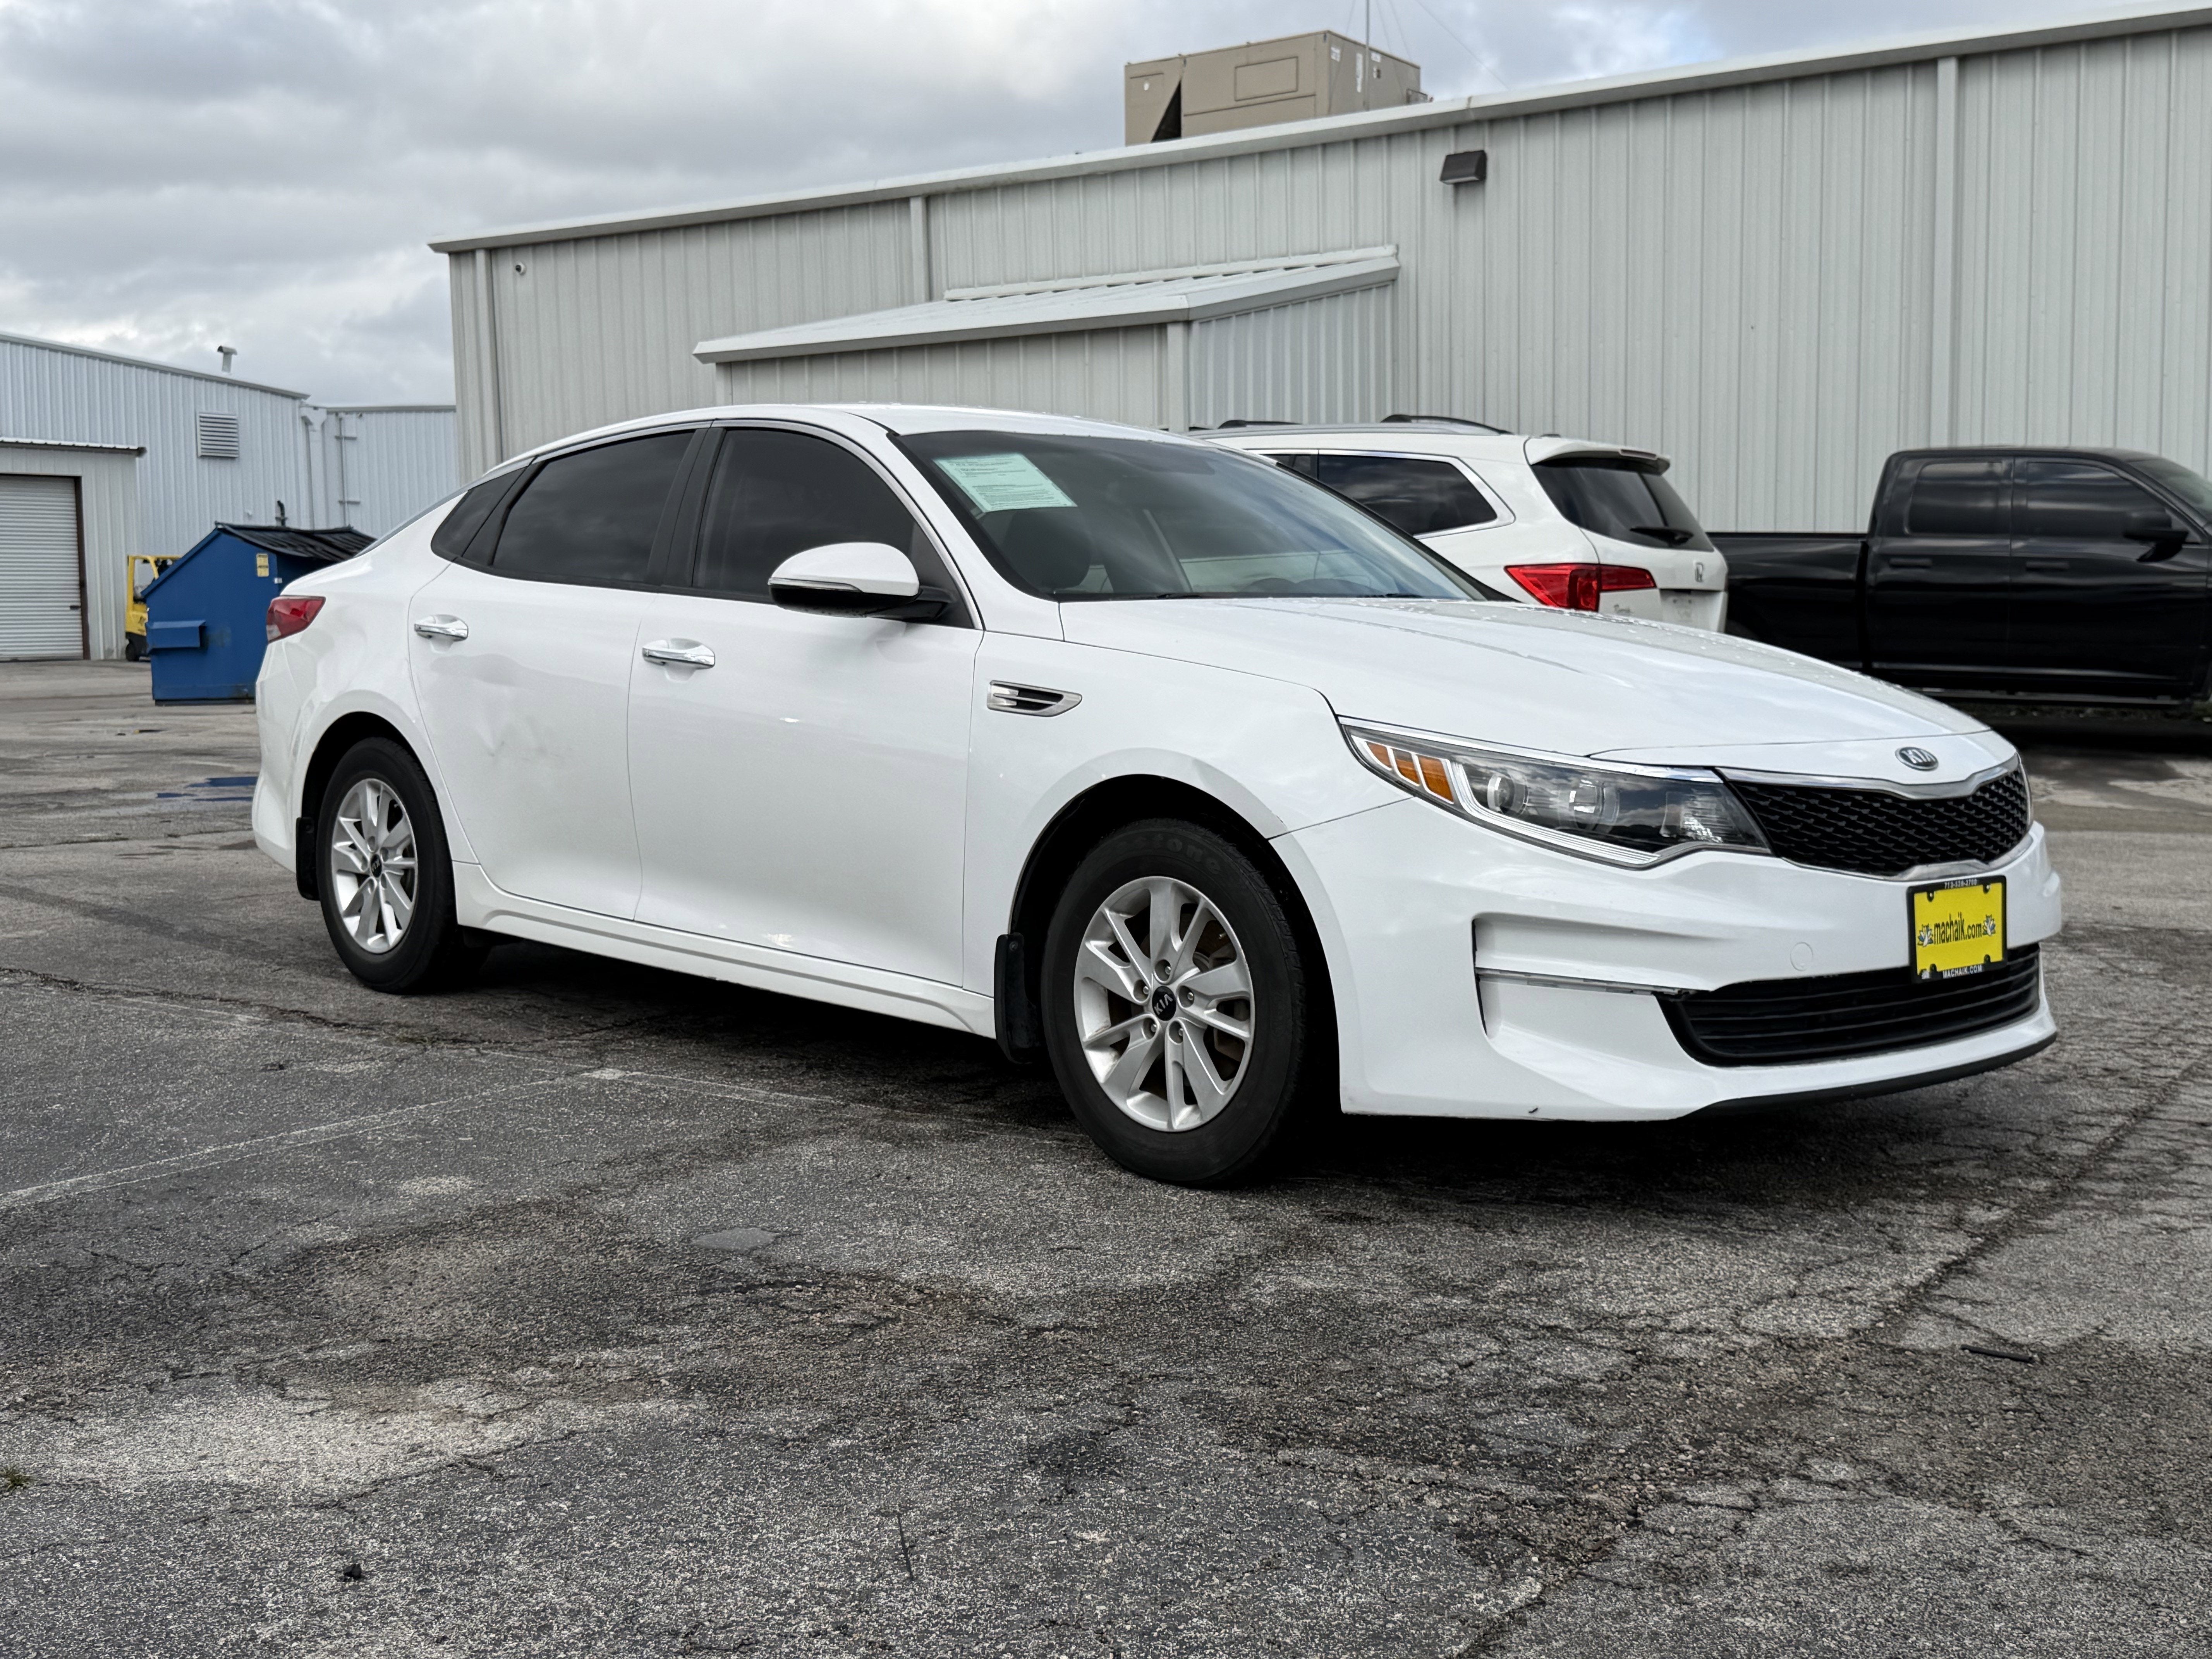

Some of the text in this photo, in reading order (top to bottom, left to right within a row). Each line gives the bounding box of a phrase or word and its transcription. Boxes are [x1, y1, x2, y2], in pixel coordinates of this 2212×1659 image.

[1901, 749, 1936, 764] KIA
[1934, 912, 1982, 945] machaik.com
[1942, 964, 1982, 979] MACHAIK.COM
[1154, 994, 1173, 1015] KIA
